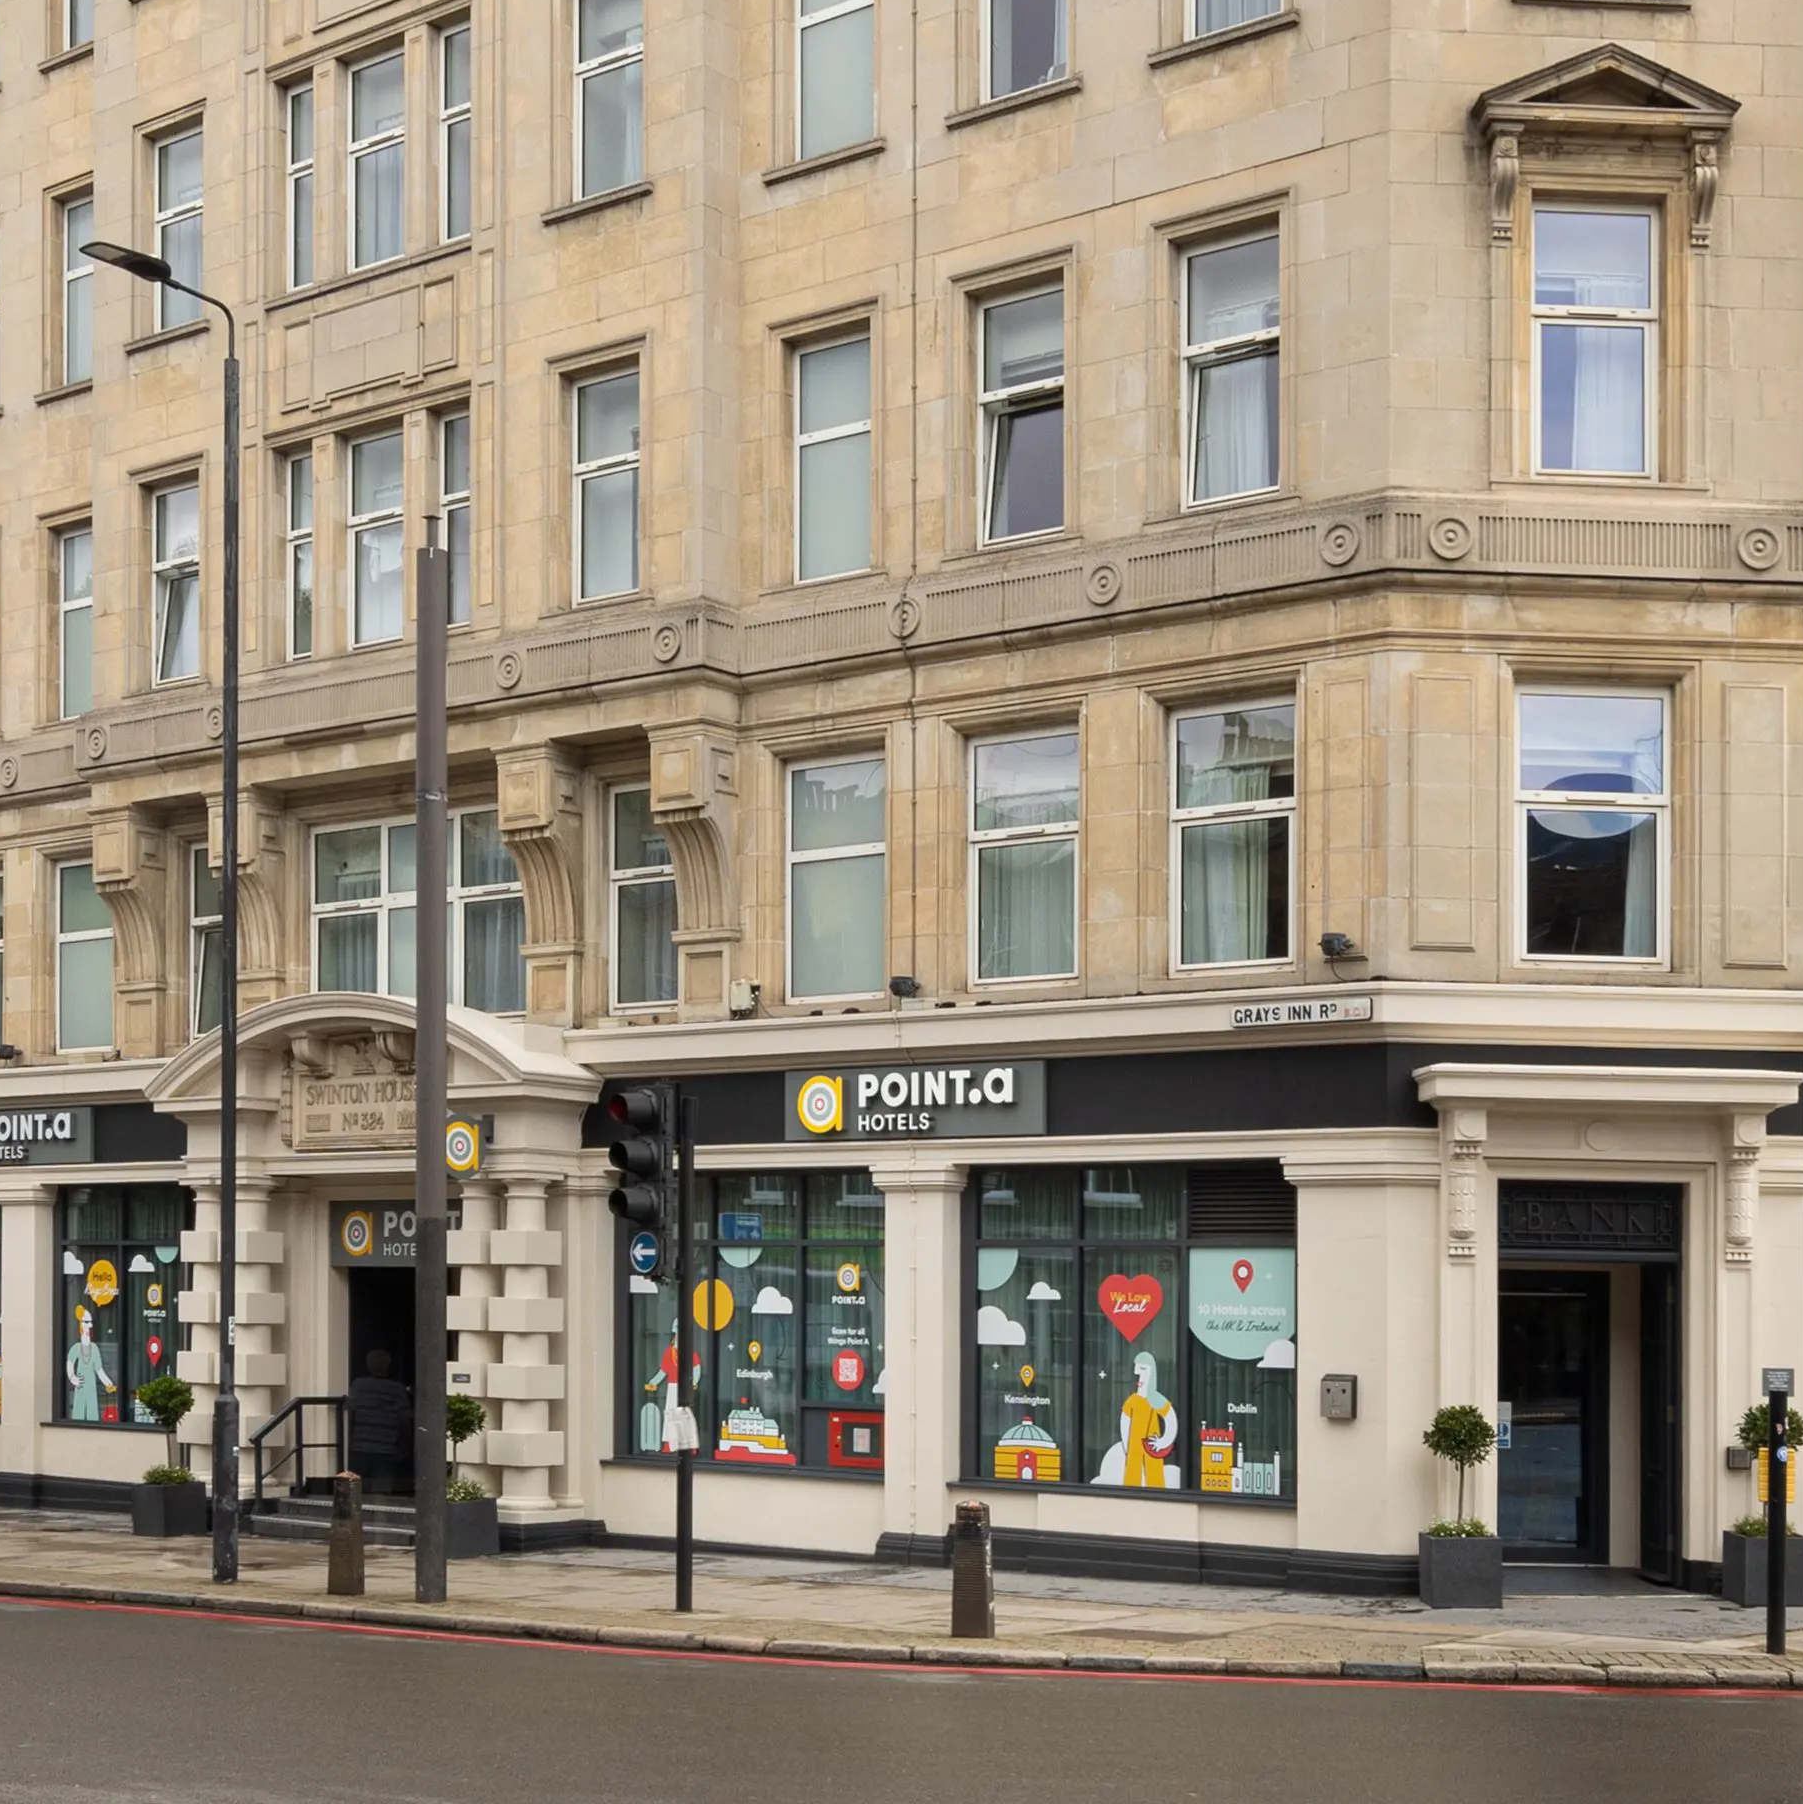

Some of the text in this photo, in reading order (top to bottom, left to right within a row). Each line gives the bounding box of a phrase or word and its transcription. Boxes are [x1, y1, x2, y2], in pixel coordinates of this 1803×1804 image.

[1234, 1007, 1281, 1024] GRAYS
[1288, 1004, 1312, 1021] INN
[306, 1081, 371, 1107] SWINTON
[360, 1110, 386, 1131] 324
[857, 1111, 931, 1132] HOTELS
[1527, 1201, 1646, 1234] BANK
[383, 1242, 417, 1257] HOTE
[92, 1271, 113, 1283] Hello
[1109, 1291, 1152, 1303] We Love
[1113, 1298, 1149, 1314] Local
[1198, 1303, 1287, 1316] 10 Hotels across
[1206, 1319, 1219, 1330] the
[1245, 1319, 1282, 1332] Ireland
[736, 1368, 774, 1381] Edinburgh
[1004, 1394, 1051, 1407] Kensington
[1228, 1402, 1258, 1415] Dublin
